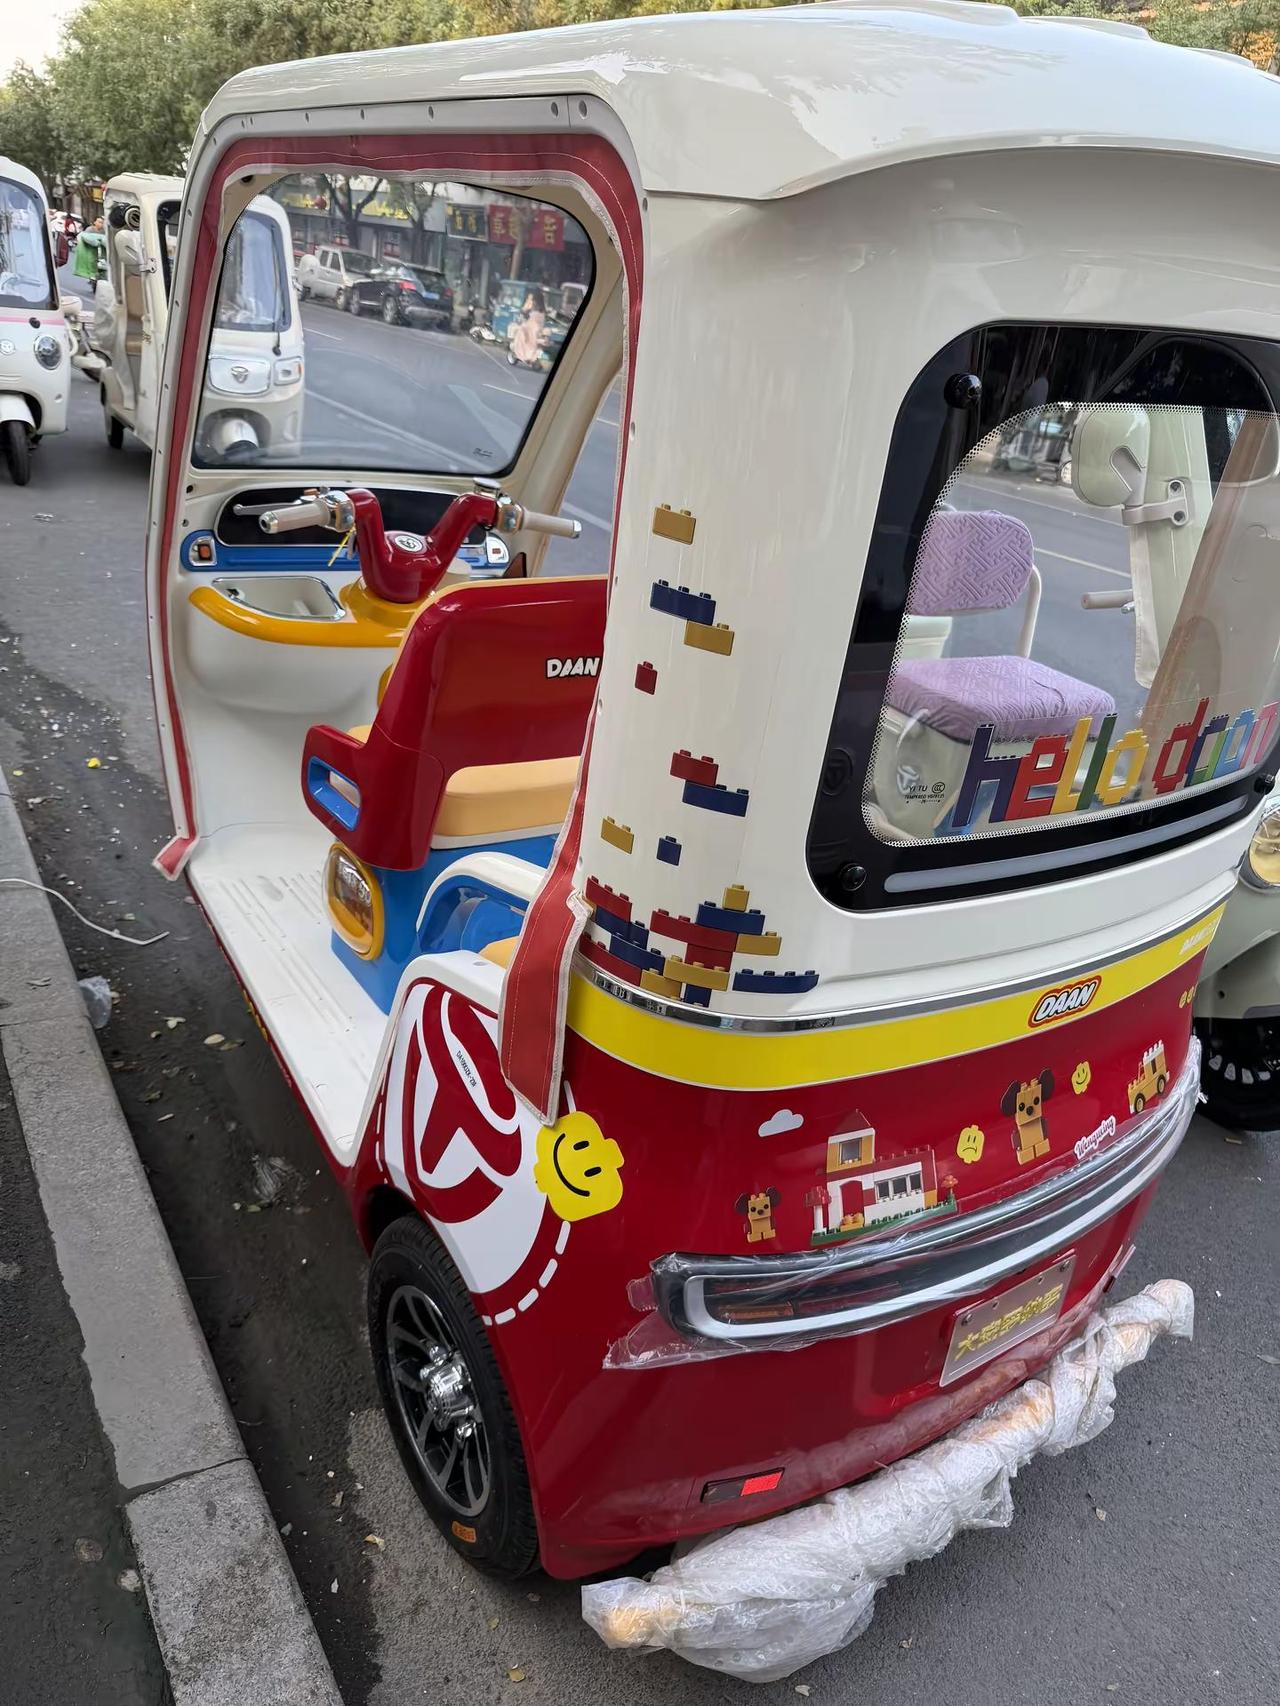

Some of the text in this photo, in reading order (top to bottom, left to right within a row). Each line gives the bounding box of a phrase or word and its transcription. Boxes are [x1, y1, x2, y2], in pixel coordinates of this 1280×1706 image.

[546, 657, 601, 679] DAAN
[952, 713, 1150, 828] hello
[918, 784, 928, 792] TU
[1034, 981, 1097, 1022] DAAN
